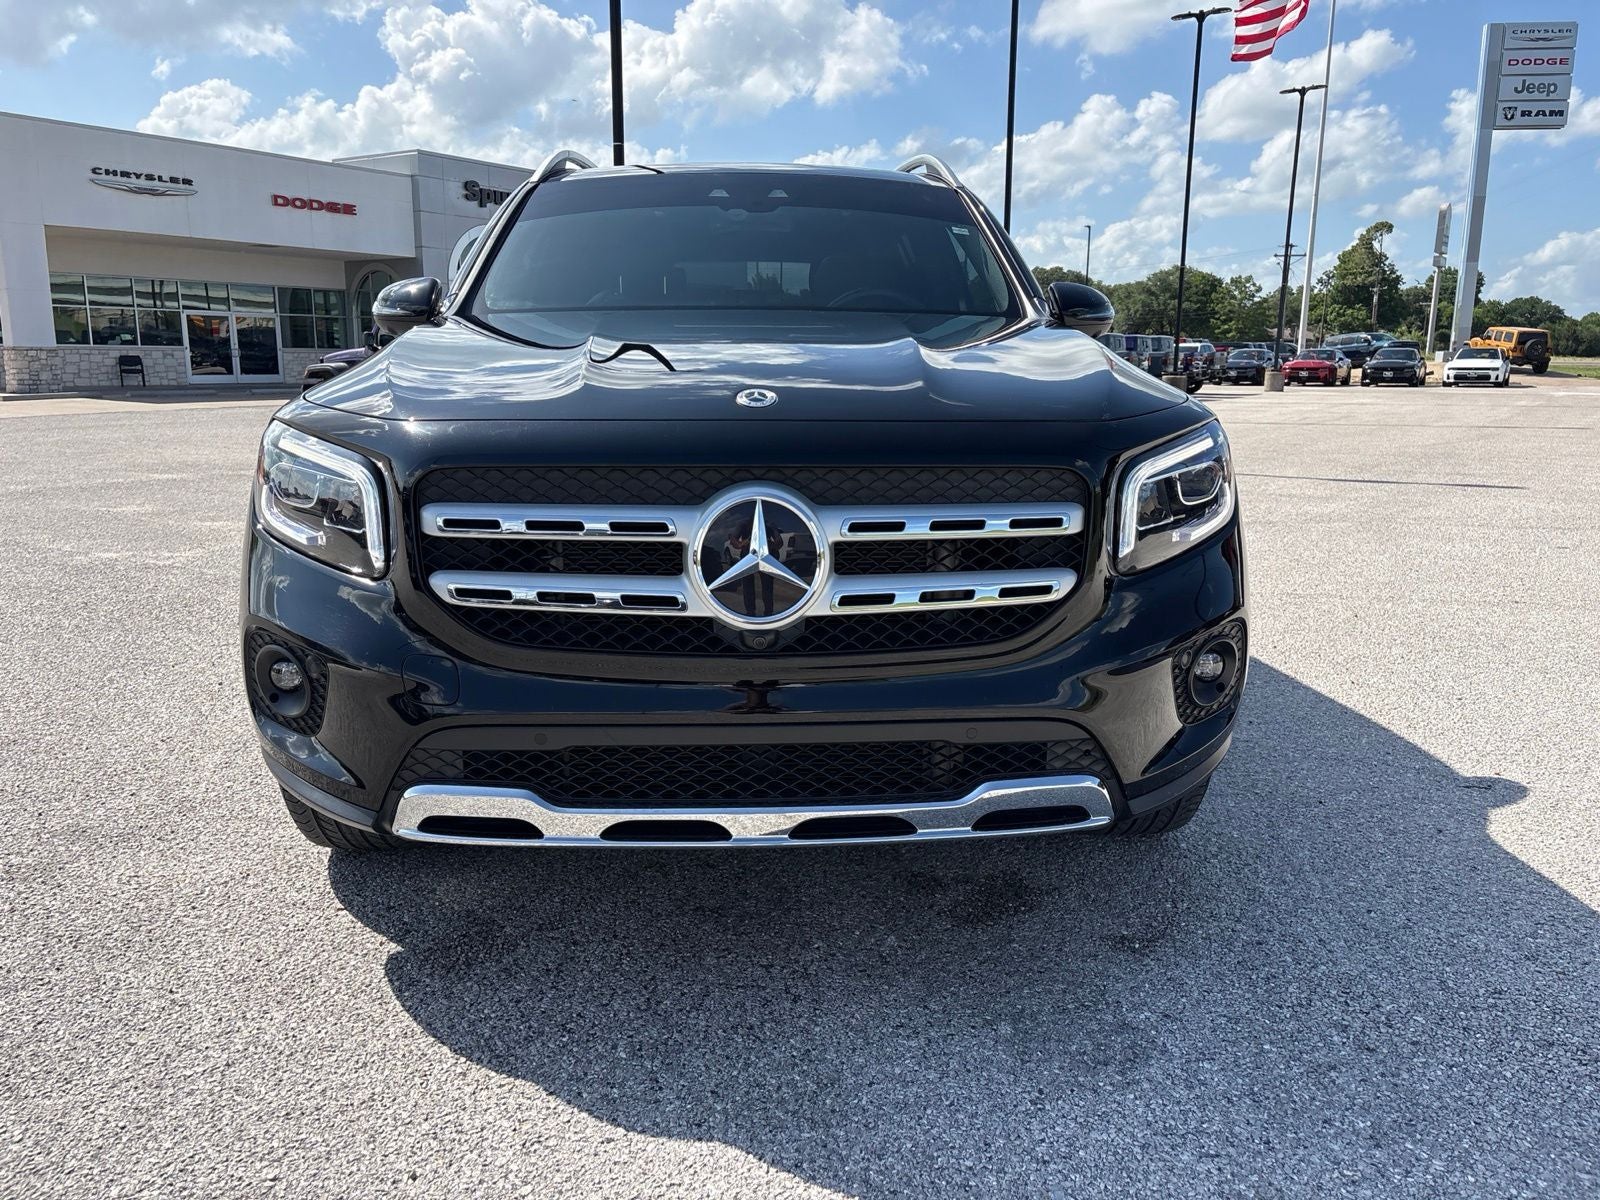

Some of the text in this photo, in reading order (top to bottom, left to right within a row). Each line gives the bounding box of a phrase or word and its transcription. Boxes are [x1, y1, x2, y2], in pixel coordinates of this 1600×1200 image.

[1507, 57, 1570, 66] DODGE
[1513, 79, 1558, 97] Jeep
[1520, 109, 1565, 118] RAM
[91, 167, 194, 186] CHRYSLER
[271, 194, 357, 215] DODGE
